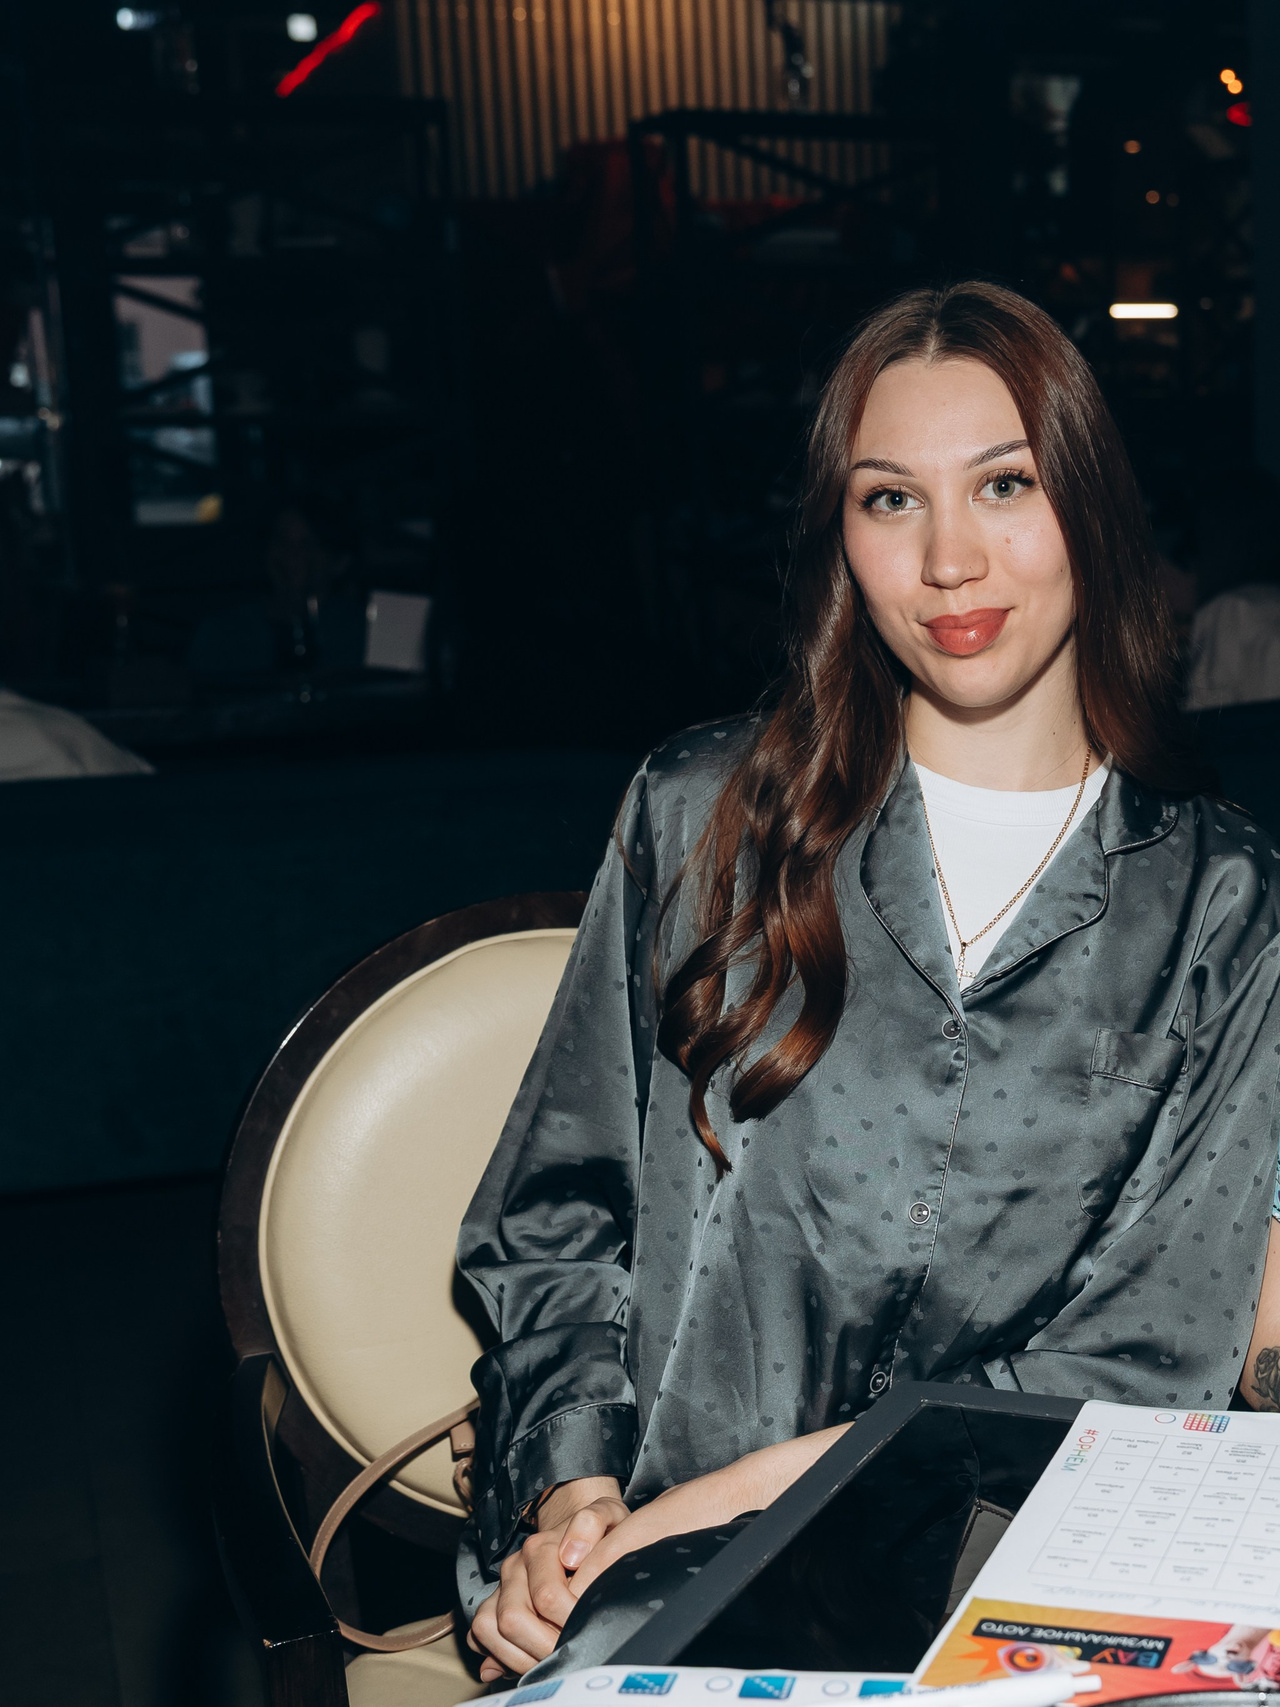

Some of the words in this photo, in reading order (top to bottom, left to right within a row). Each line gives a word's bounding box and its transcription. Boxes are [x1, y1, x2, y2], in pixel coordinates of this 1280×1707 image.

[980, 1621, 1030, 1637] ЛОТО
[1031, 1627, 1165, 1650] МУЗЫКАЛЬНОЕ
[1092, 1647, 1160, 1668] ВАУ
